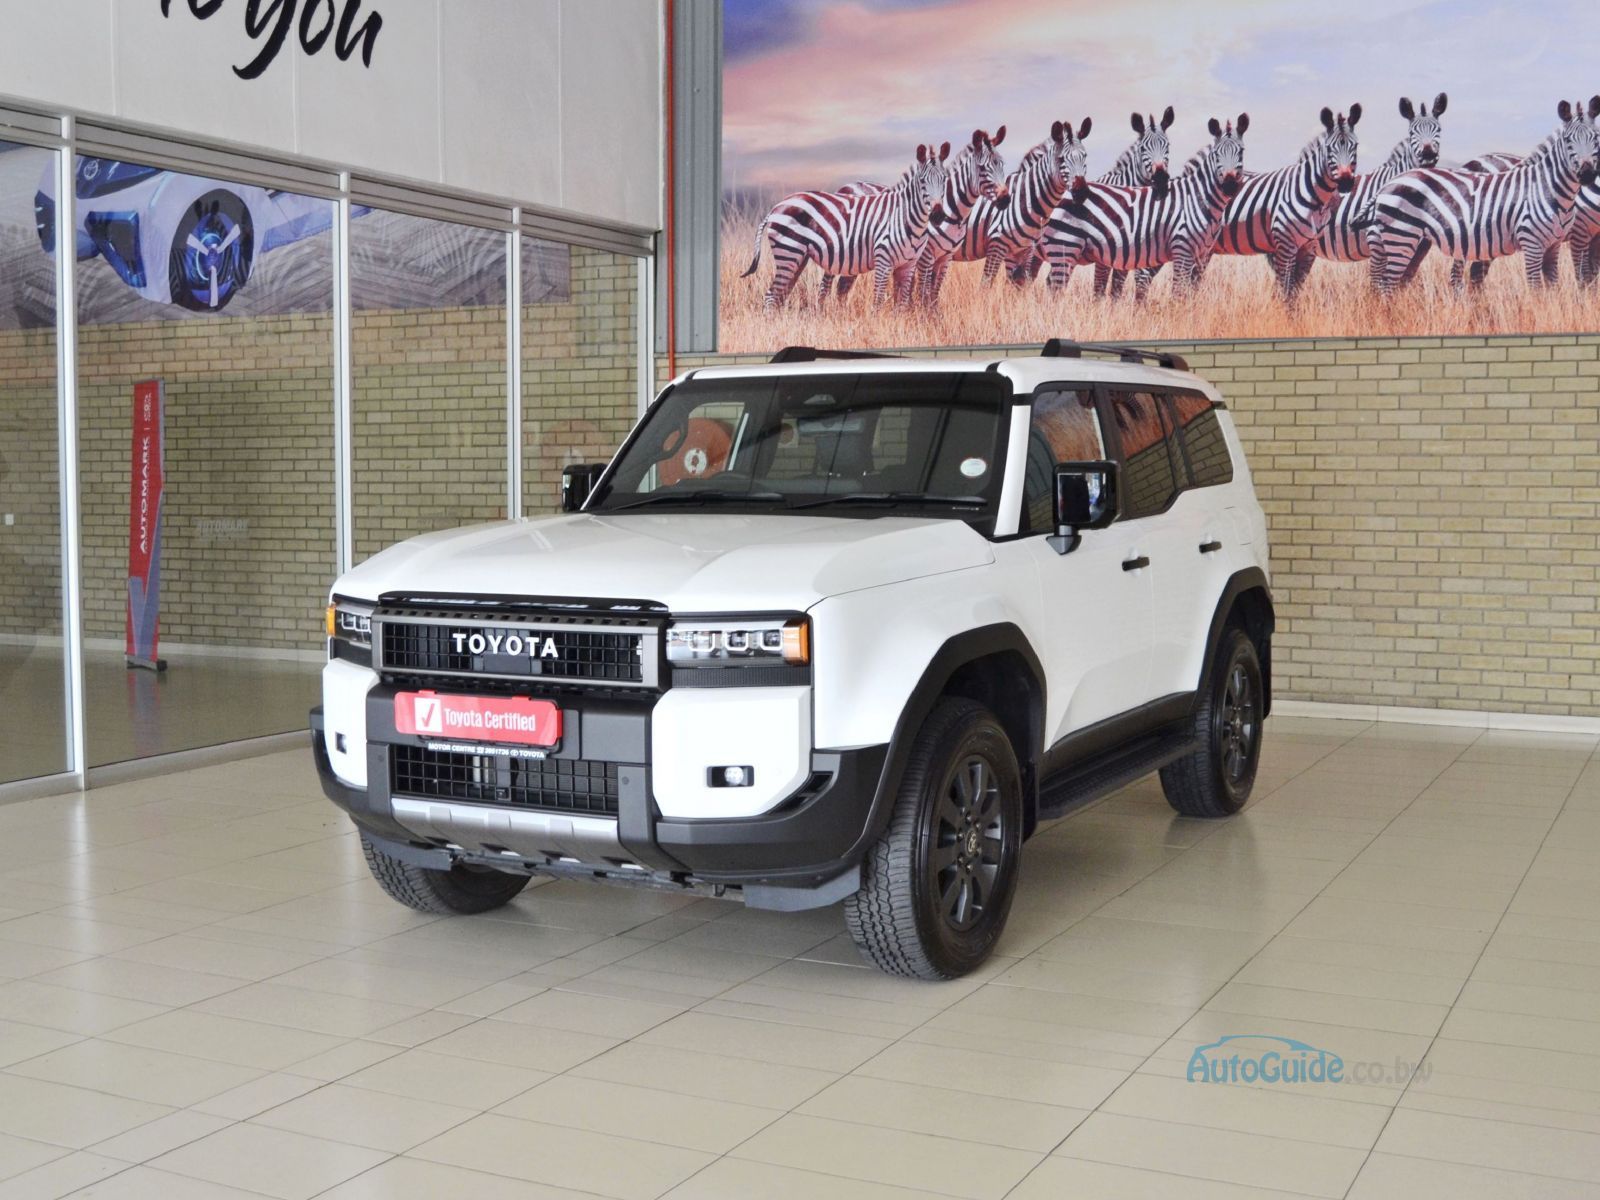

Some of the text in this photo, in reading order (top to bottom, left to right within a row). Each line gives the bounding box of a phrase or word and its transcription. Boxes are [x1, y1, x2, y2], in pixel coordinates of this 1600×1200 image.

[232, 0, 383, 80] you
[139, 437, 149, 554] AUTOMARK
[452, 633, 559, 658] TOYOTA
[444, 709, 536, 731] Toyota Certified
[428, 742, 451, 752] MOTOR
[452, 744, 476, 754] CENTRE
[519, 750, 545, 759] TOYOTA
